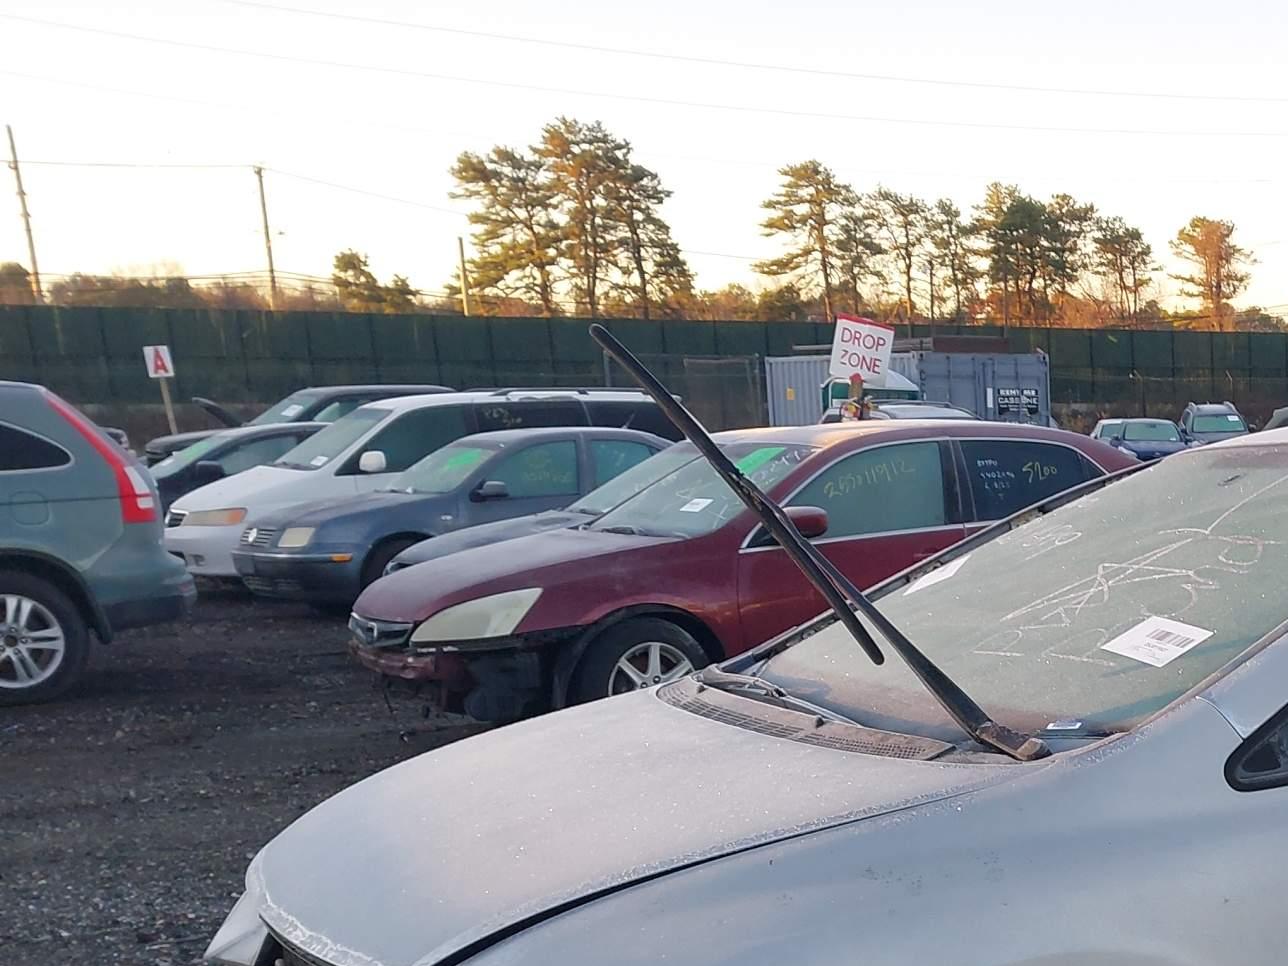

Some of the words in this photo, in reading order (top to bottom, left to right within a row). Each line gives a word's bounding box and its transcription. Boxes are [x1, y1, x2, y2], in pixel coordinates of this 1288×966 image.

[841, 326, 886, 352] DROP
[153, 350, 169, 375] A
[840, 349, 882, 375] ZONE
